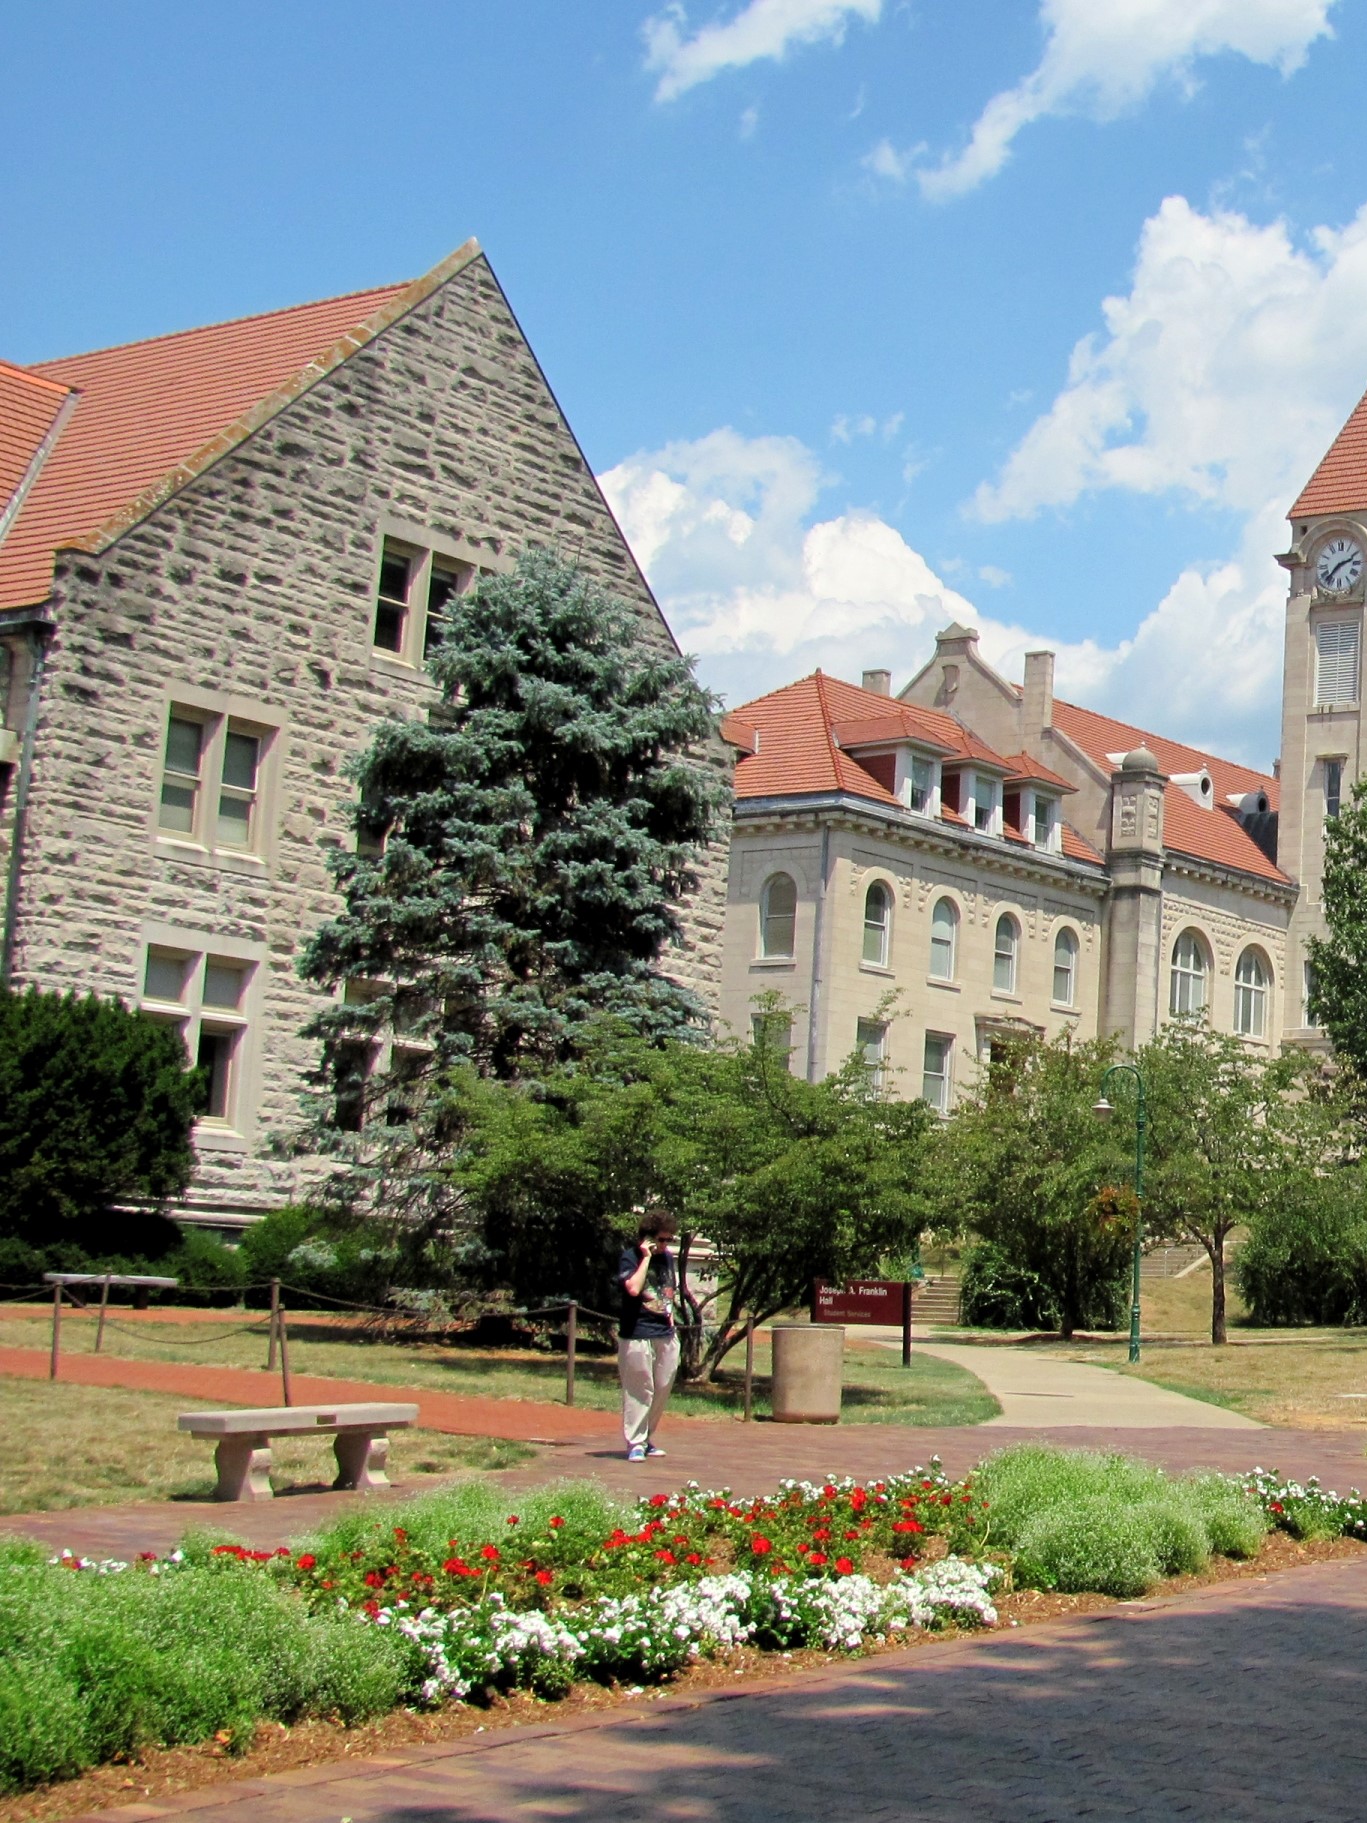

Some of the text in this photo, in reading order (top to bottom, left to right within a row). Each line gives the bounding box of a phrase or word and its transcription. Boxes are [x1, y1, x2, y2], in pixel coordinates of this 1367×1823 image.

[819, 1285, 846, 1296] Josep
[859, 1286, 888, 1296] Franklin
[819, 1296, 833, 1304] Hall
